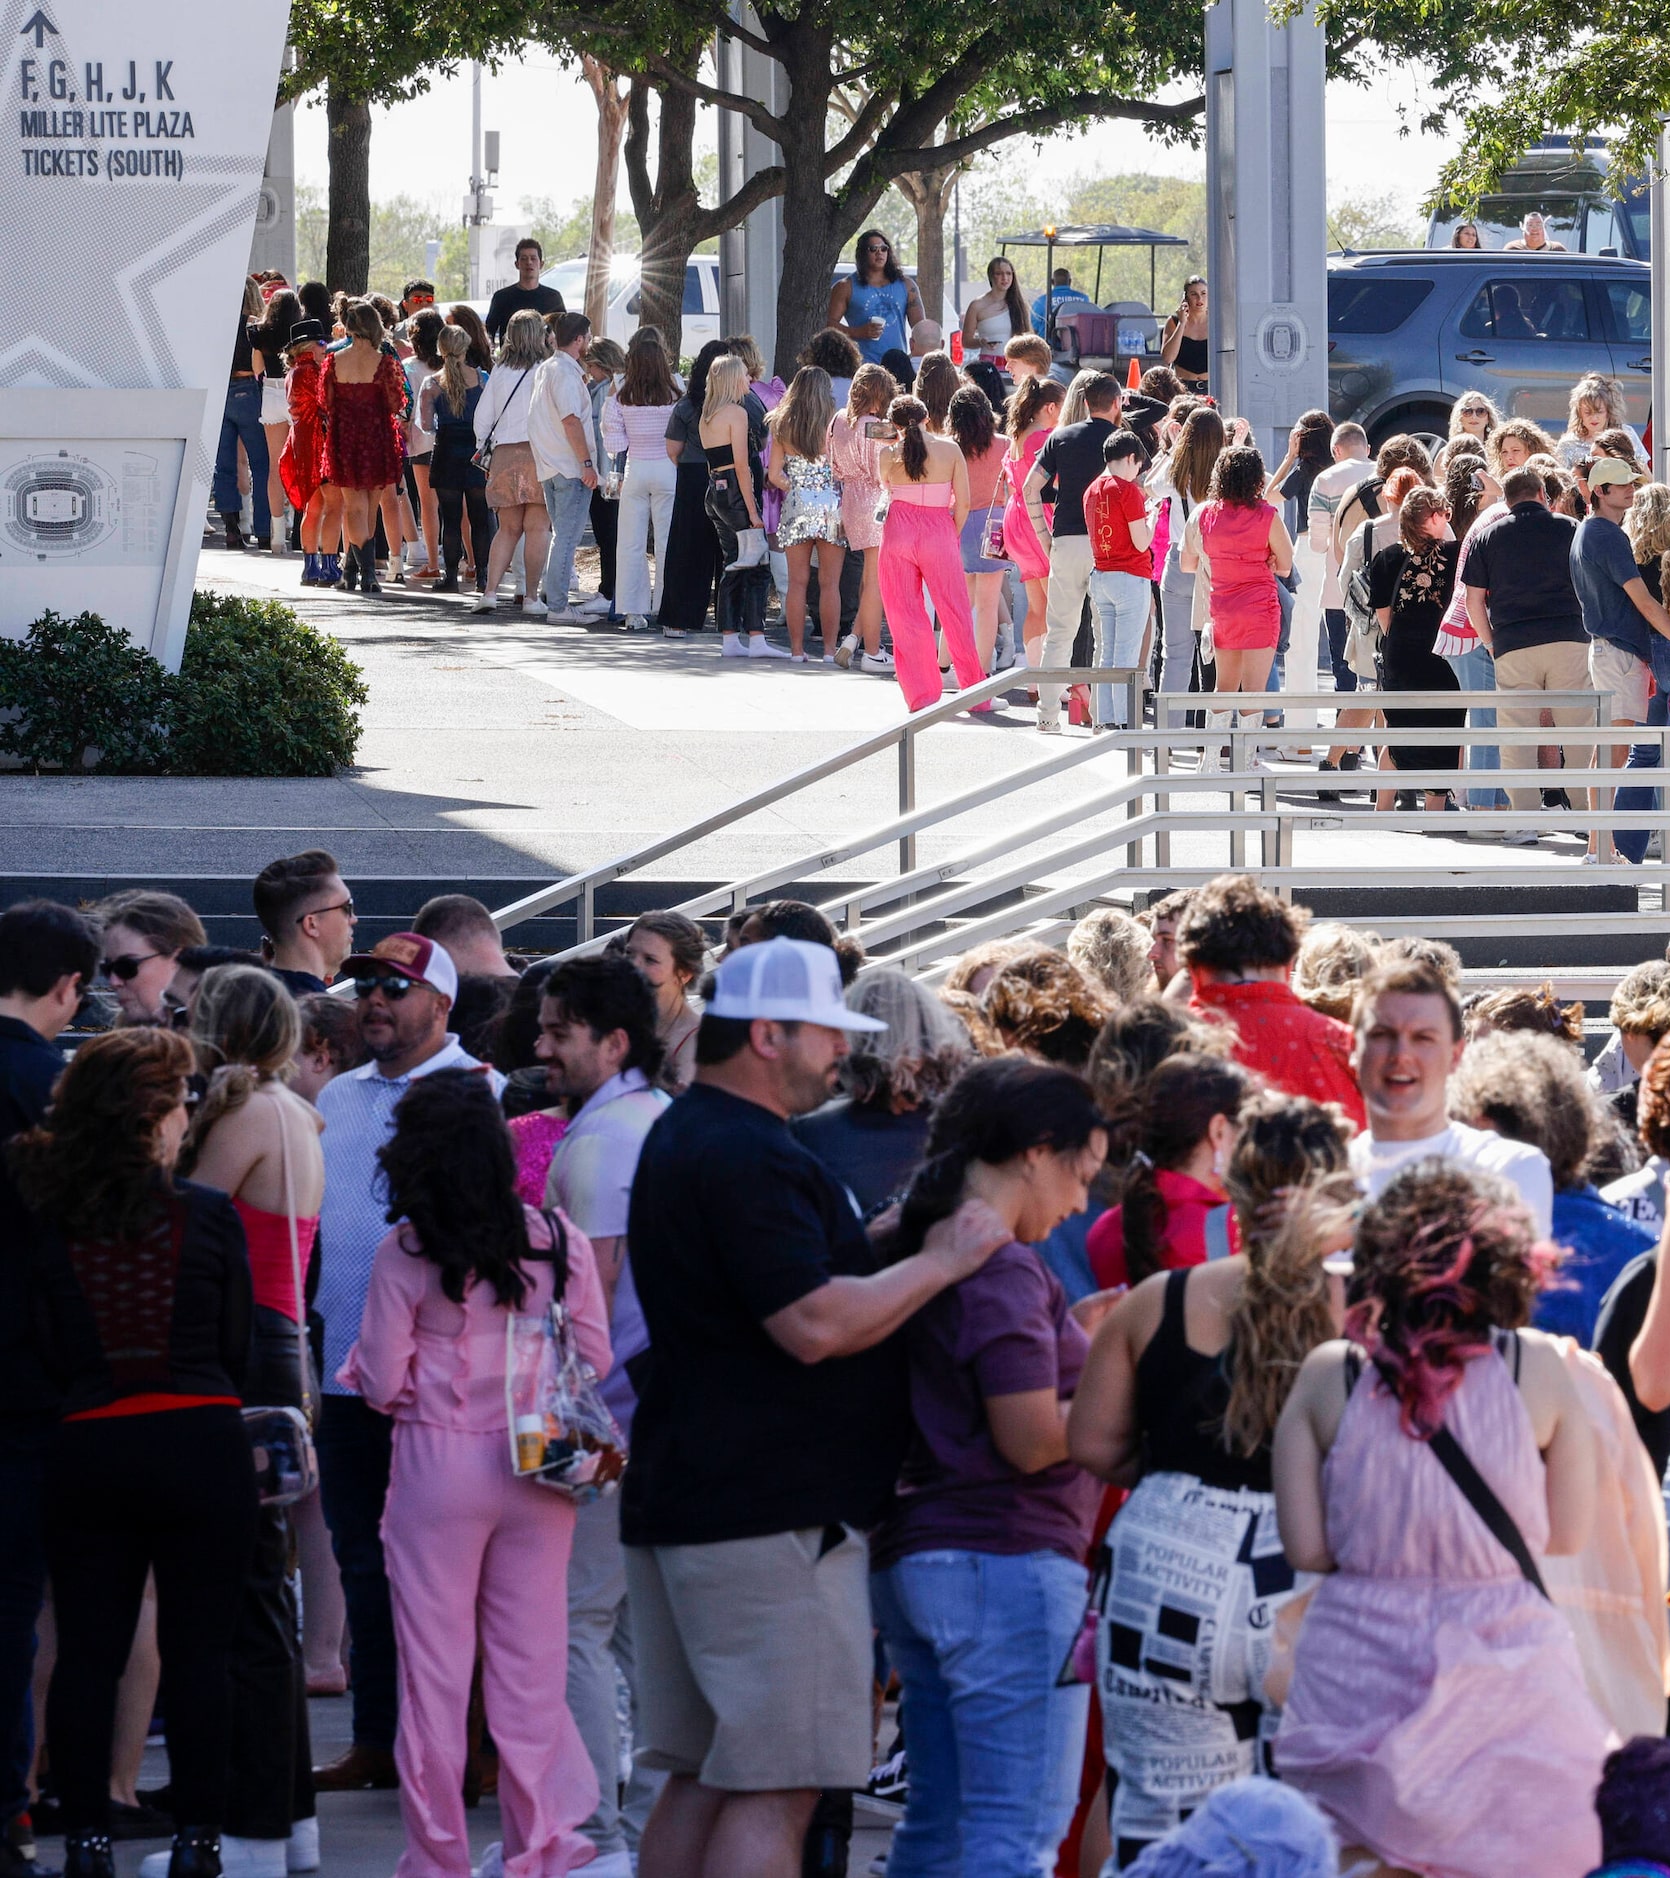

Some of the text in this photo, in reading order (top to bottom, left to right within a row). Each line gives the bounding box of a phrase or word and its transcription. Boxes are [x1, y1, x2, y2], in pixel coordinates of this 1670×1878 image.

[21, 60, 175, 103] F, G, H, J, K
[21, 111, 195, 138] MILLER LITE PLAZA
[22, 150, 184, 182] TICKETS (SOUTH)
[1051, 296, 1085, 306] ECURITY
[1146, 1543, 1229, 1582] POPULAR
[1144, 1562, 1225, 1600] ACTIVITY
